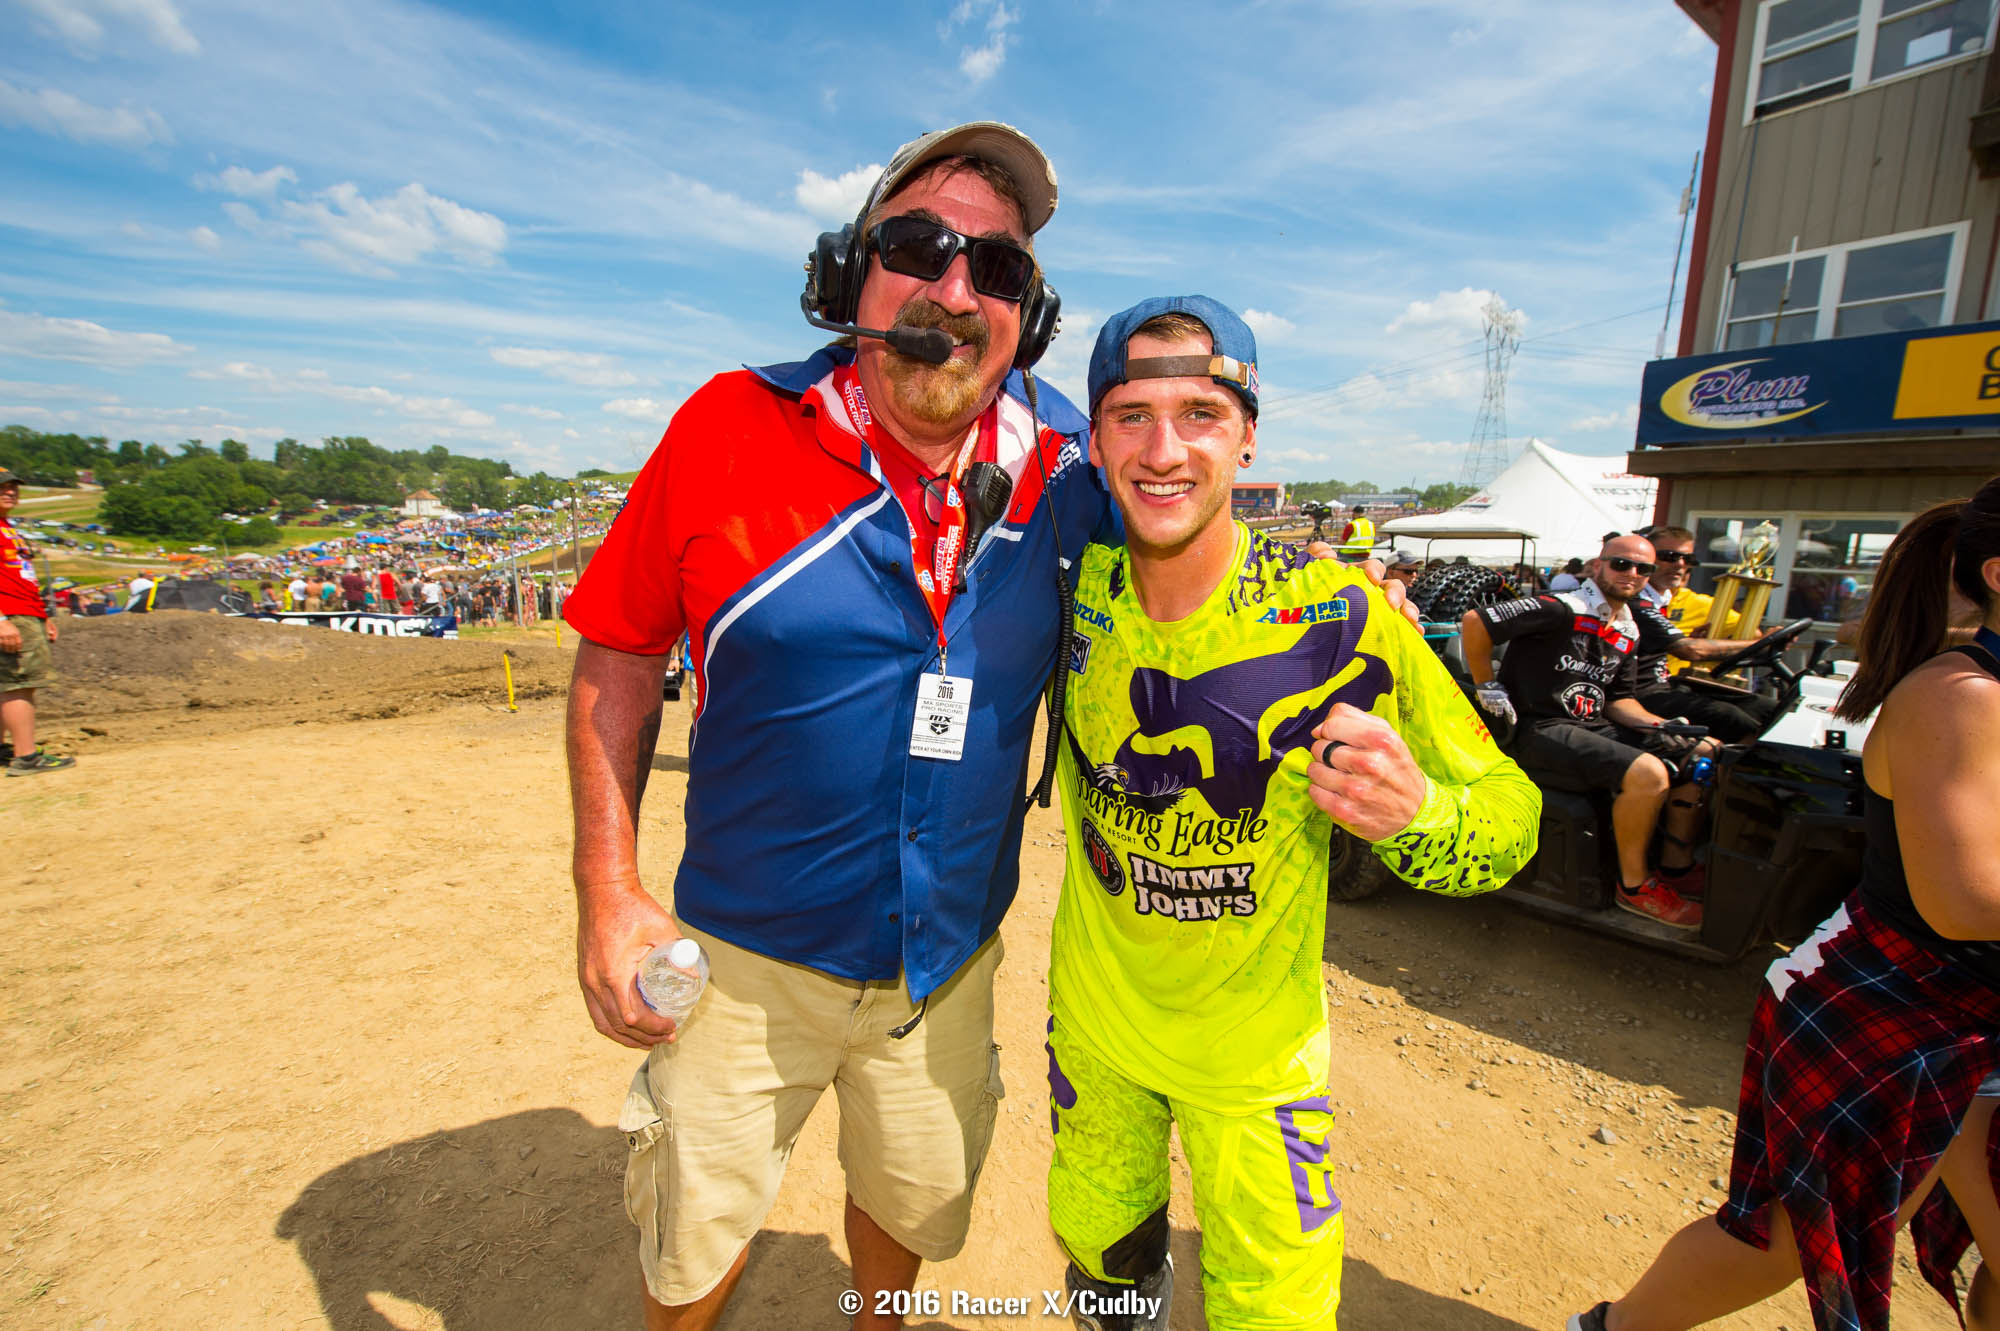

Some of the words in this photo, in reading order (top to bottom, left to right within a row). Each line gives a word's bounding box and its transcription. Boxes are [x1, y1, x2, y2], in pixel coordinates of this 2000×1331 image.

[1689, 368, 1810, 408] Plum
[938, 539, 946, 552] OIL
[943, 525, 959, 595] MOTOCROSS
[936, 552, 944, 579] LUCAS
[1073, 598, 1115, 634] UZUKI
[1256, 604, 1317, 624] AMA
[937, 685, 954, 700] 2016
[1078, 776, 1164, 851] oaring
[1166, 808, 1269, 857] Eagle
[1107, 827, 1137, 845] RESORT
[1130, 855, 1252, 891] JIMMY
[1135, 885, 1255, 920] JOHN'S
